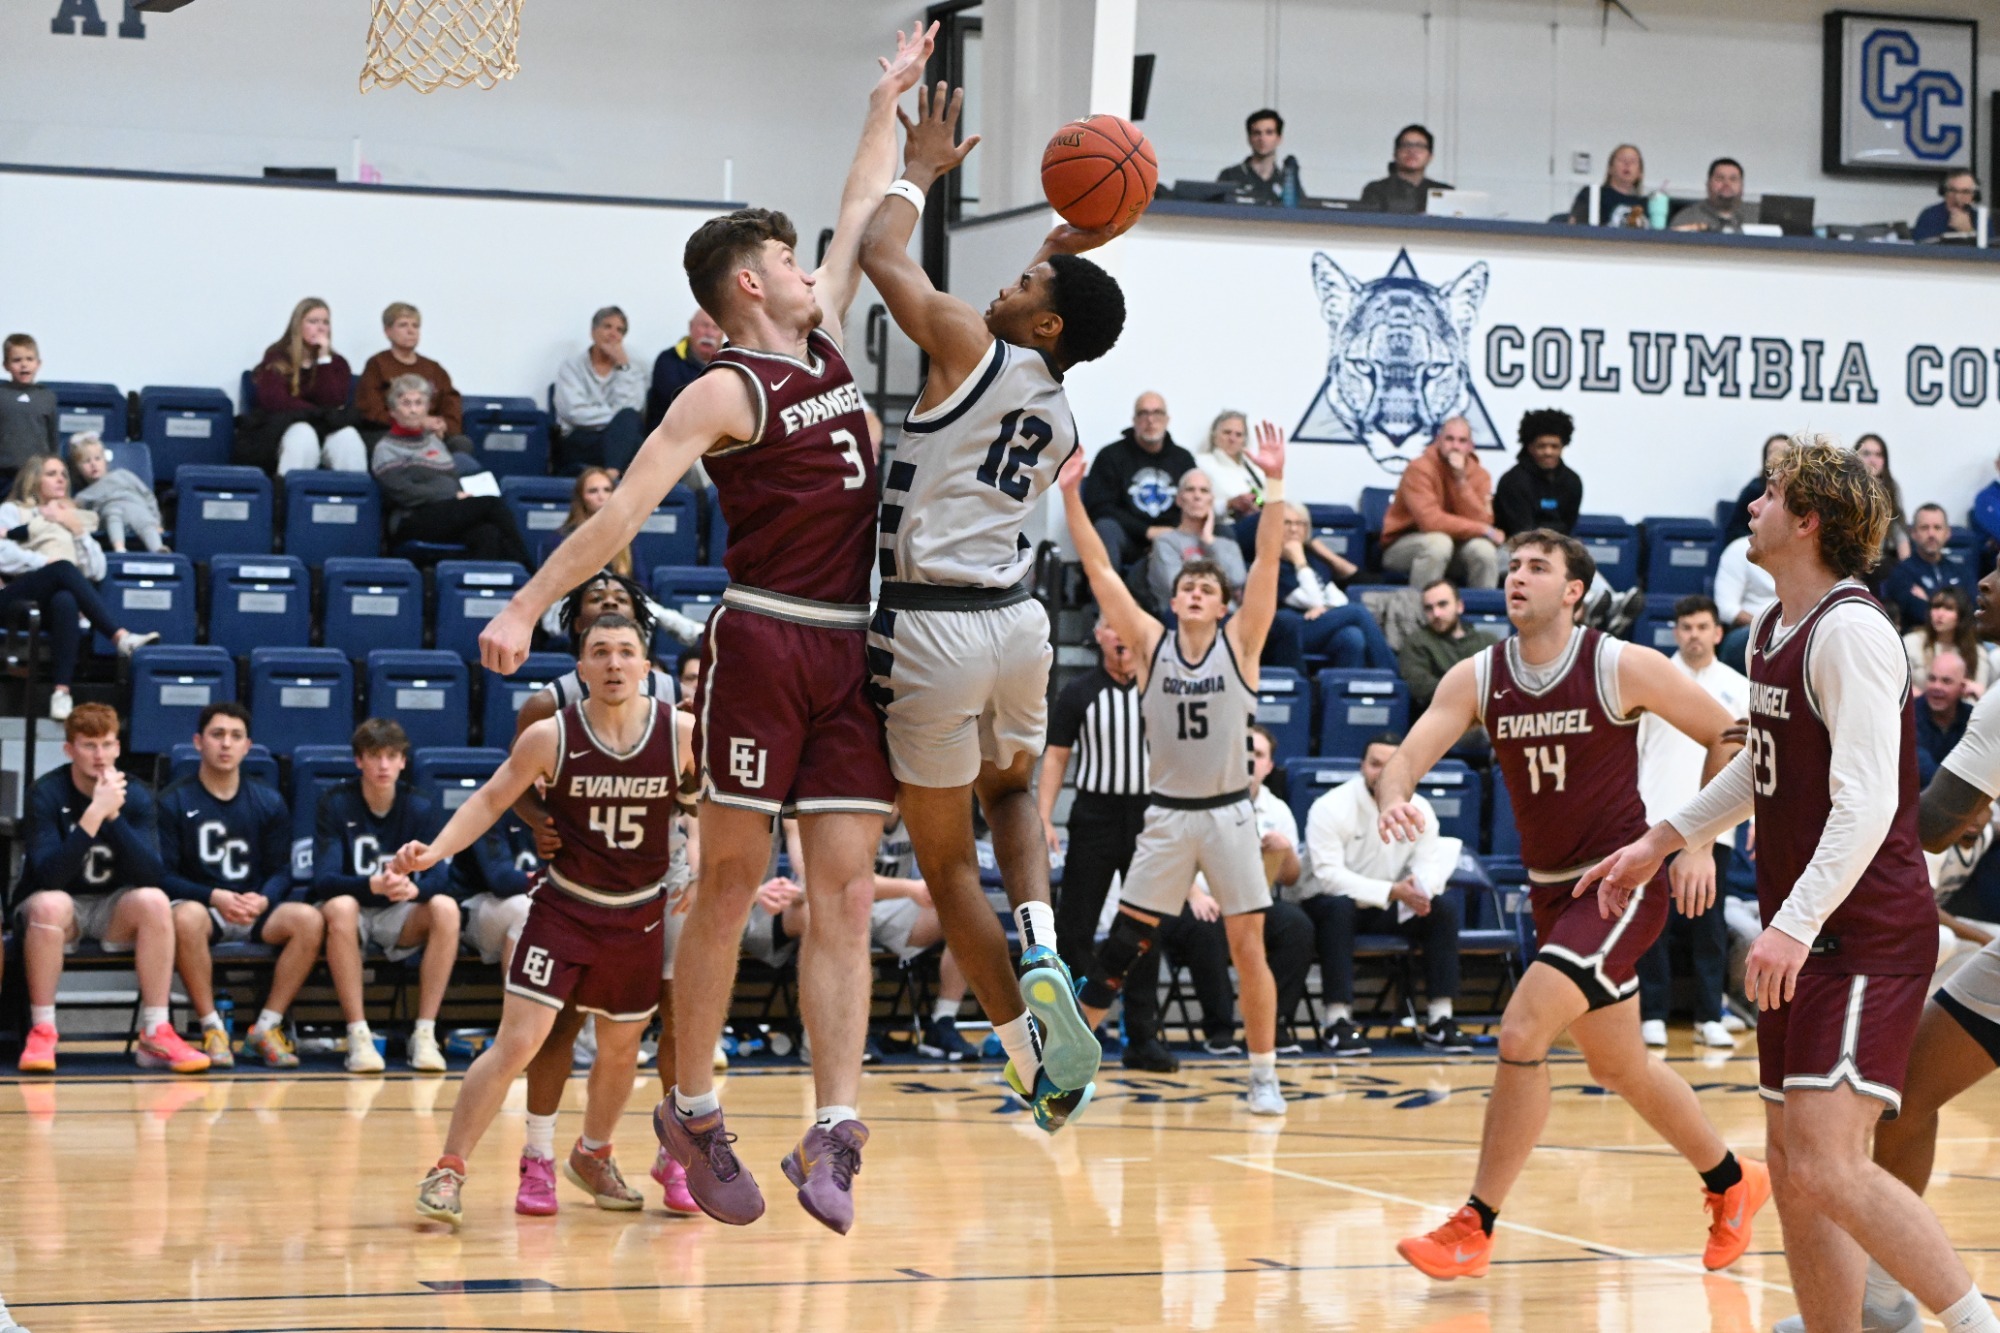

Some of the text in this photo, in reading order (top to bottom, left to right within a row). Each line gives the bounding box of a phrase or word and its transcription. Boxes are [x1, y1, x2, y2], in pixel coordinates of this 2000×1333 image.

[1861, 28, 1963, 161] CC
[1486, 325, 2000, 408] COLUMBIA CO
[779, 381, 864, 437] EVANGE
[828, 428, 867, 491] 3
[976, 408, 1053, 503] 12
[1177, 702, 1208, 740] 15
[1497, 708, 1593, 739] EVANGEL
[1749, 680, 1791, 720] VANGEL
[1523, 744, 1566, 794] 14
[1751, 726, 1777, 797] 23
[569, 776, 669, 798] EVANGEL
[198, 822, 249, 880] CC
[589, 806, 648, 849] 45
[82, 843, 112, 883] C
[354, 836, 398, 877] C
